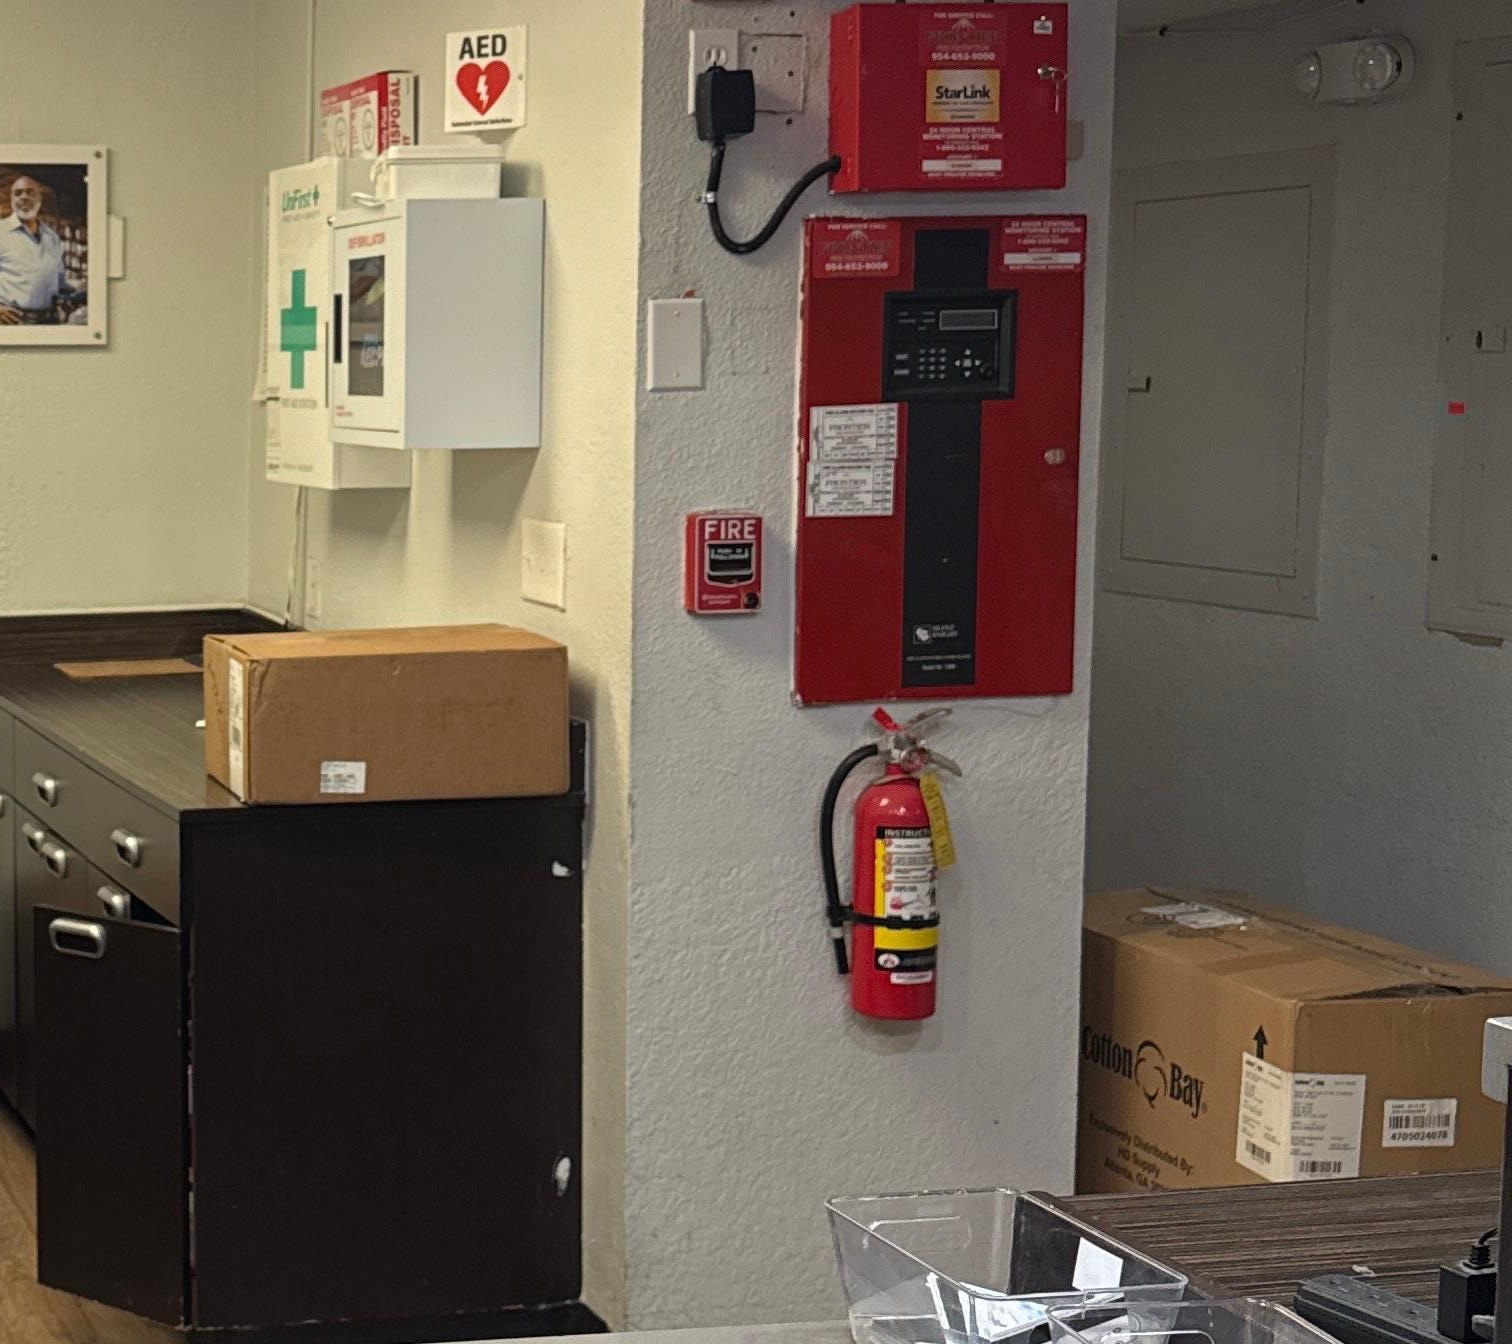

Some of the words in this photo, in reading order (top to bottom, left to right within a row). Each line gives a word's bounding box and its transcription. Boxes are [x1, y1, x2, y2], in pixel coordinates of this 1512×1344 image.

[458, 33, 507, 60] AED
[935, 84, 991, 99] StarLink
[389, 78, 400, 146] ISPOSAL
[704, 519, 757, 540] FIRE
[1081, 1026, 1133, 1080] Cotton
[1169, 1062, 1204, 1119] Bay
